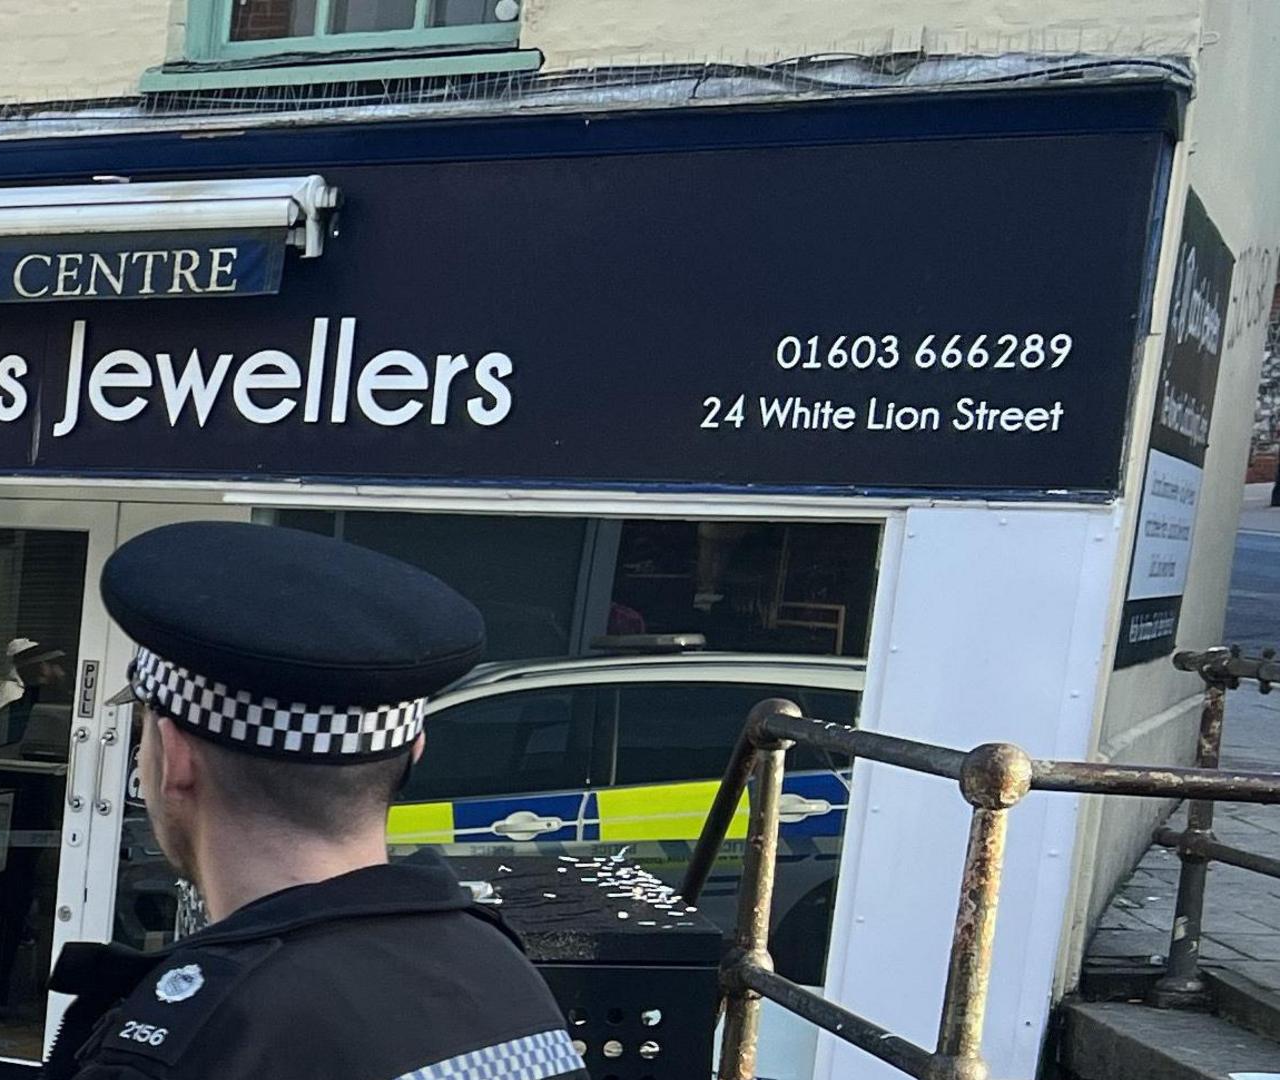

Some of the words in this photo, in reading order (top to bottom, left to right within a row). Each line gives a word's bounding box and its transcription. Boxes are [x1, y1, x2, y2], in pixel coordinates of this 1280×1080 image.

[13, 247, 238, 296] CENTRE
[776, 335, 900, 369] 01603
[914, 334, 1073, 368] 666289
[52, 317, 513, 437] Jewellers
[700, 396, 745, 428] 24
[760, 397, 856, 430] White
[867, 401, 940, 431] Lion
[952, 400, 1064, 432] Street
[82, 664, 95, 714] PULL
[118, 1020, 169, 1046] 2156
